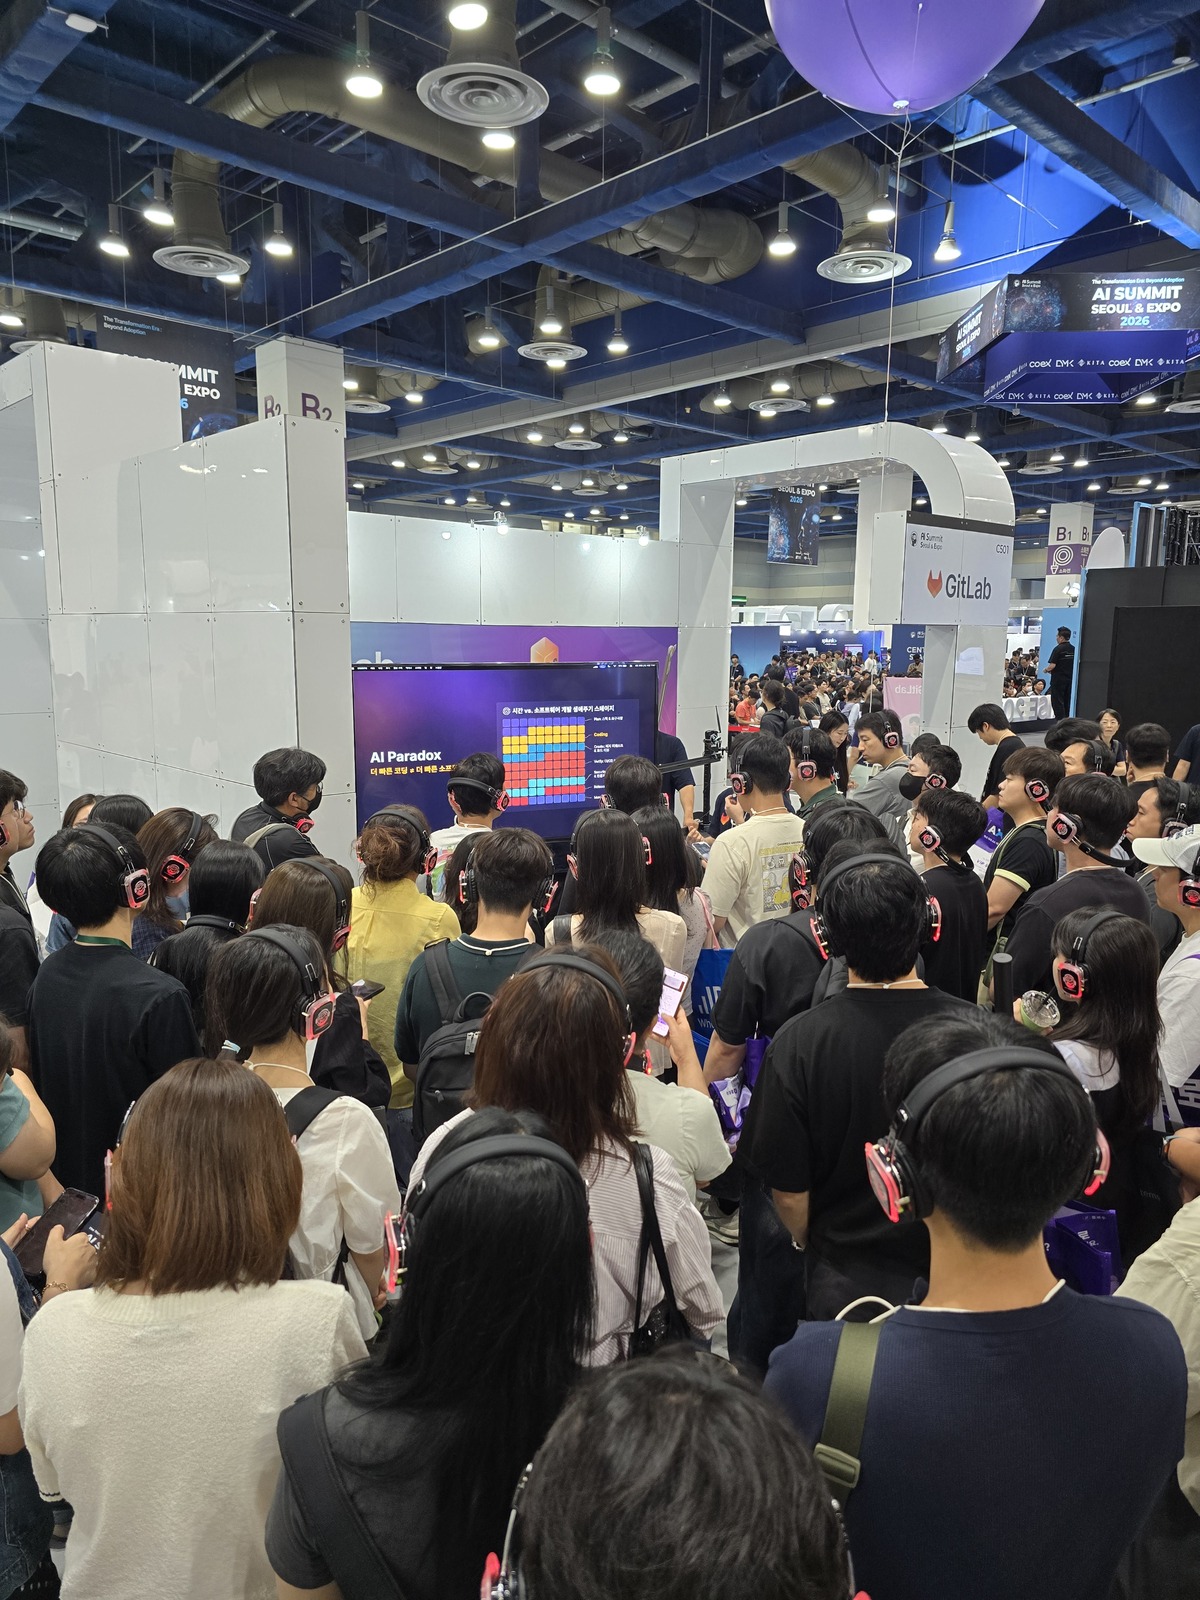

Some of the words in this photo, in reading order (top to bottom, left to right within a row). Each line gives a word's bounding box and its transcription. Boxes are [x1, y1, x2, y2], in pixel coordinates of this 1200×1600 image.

[1092, 287, 1110, 300] AI
[1114, 286, 1182, 300] SUMMIT
[1091, 304, 1132, 314] SEOUL
[1134, 303, 1144, 313] &
[1146, 302, 1181, 313] EXPO
[114, 317, 152, 331] Transformation
[1120, 316, 1150, 326] 2026
[103, 322, 122, 332] Beyond
[122, 326, 146, 336] Adoption
[1029, 358, 1052, 368] coex
[1109, 358, 1132, 367] coex
[184, 383, 220, 400] EXPO
[301, 392, 332, 420] B2
[778, 486, 796, 494] SEOUL
[801, 488, 816, 497] EXPO
[926, 533, 943, 542] Summit
[1056, 526, 1071, 541] B1
[1082, 526, 1089, 541] B1
[946, 574, 992, 600] GitLab
[370, 752, 384, 763] AI
[388, 750, 442, 762] Paradox
[379, 767, 393, 775] 빠른
[394, 766, 408, 775] 코딩
[424, 765, 437, 773] 빠른
